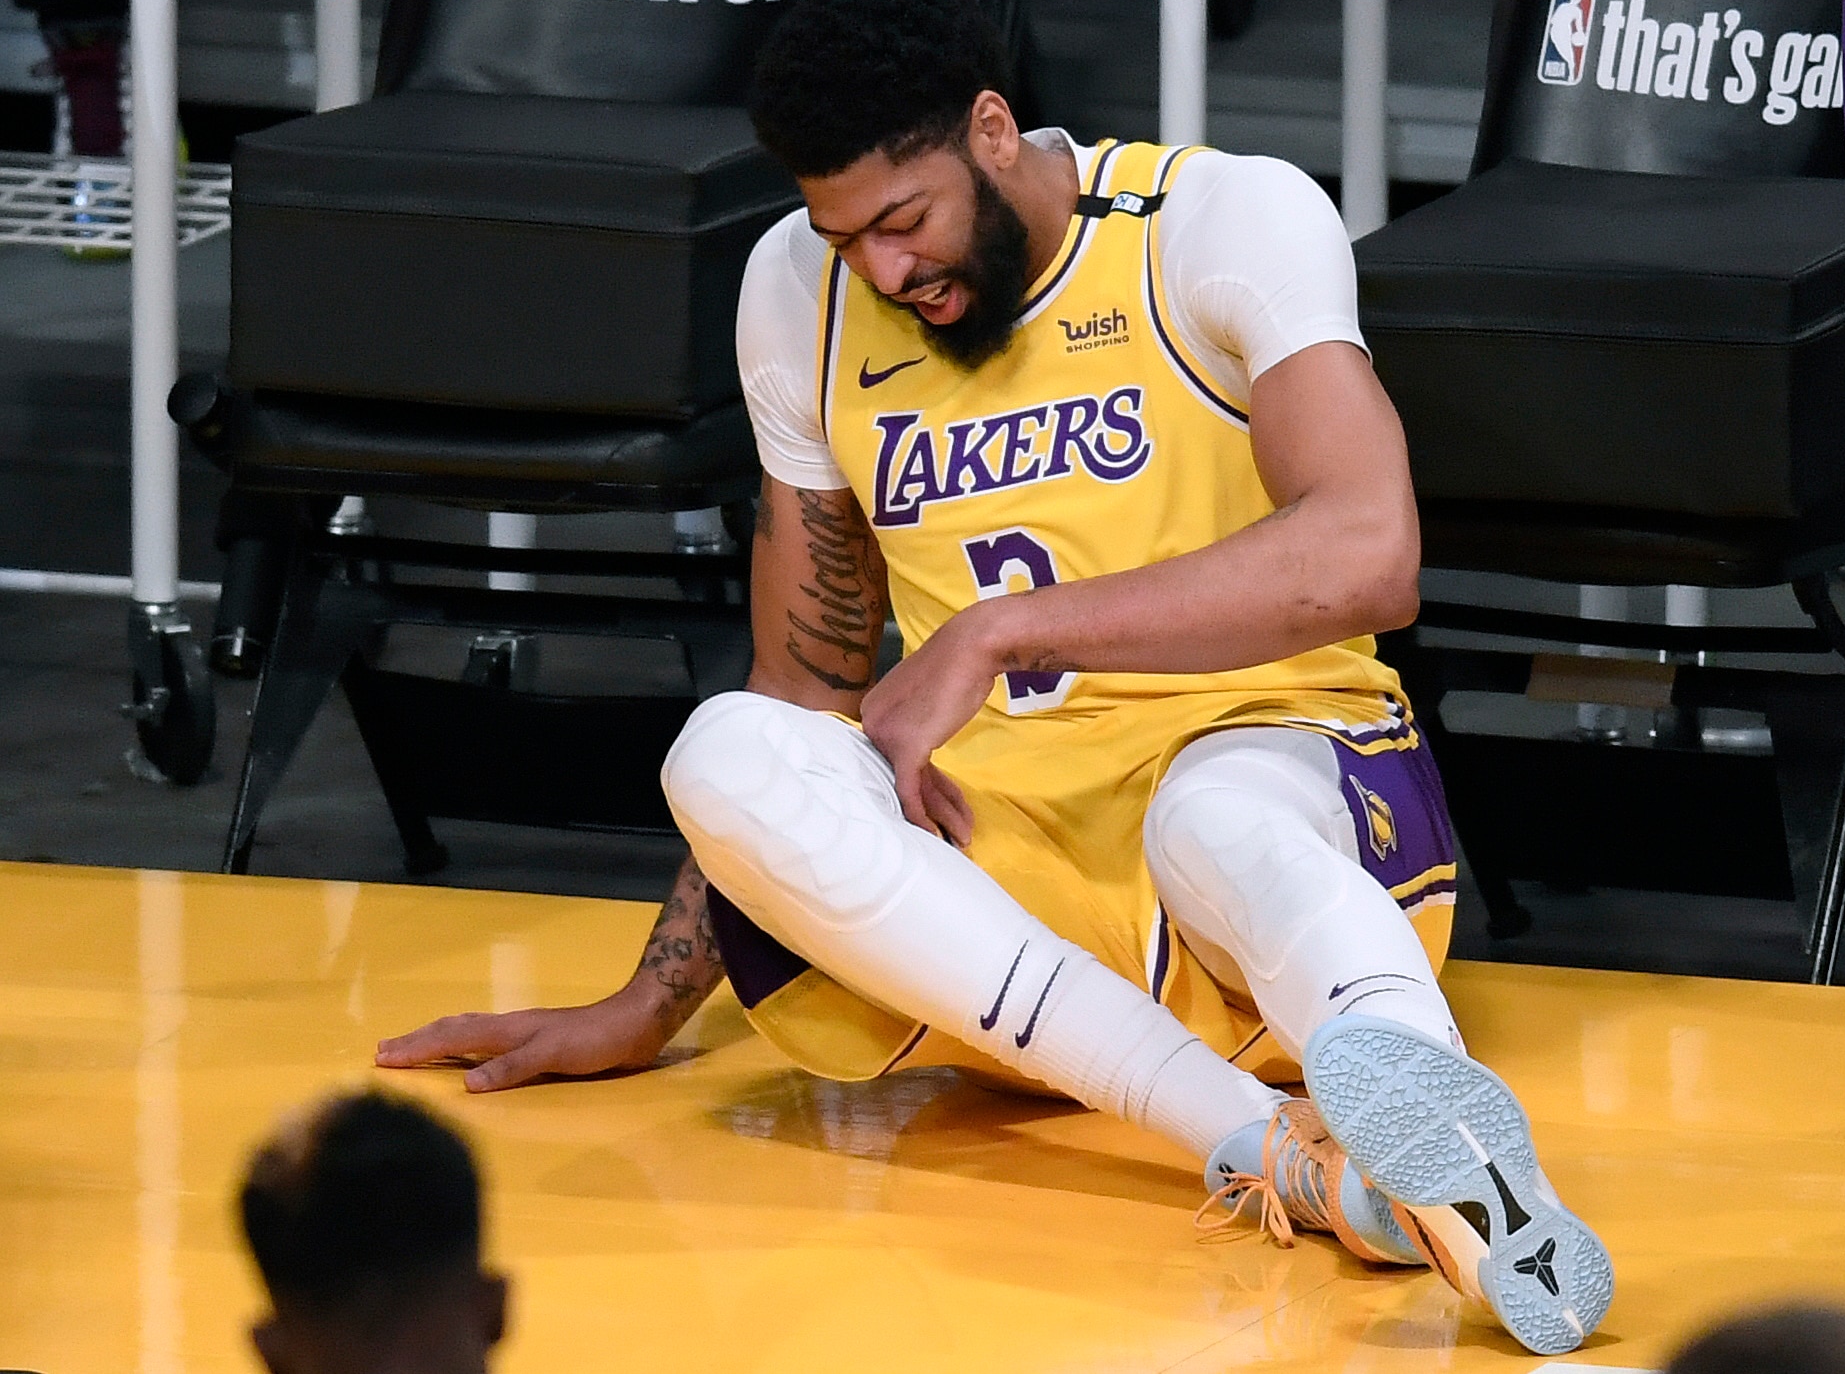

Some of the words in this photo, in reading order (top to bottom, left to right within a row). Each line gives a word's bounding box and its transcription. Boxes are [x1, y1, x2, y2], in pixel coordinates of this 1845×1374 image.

[1762, 32, 1844, 126] ga
[1057, 307, 1128, 341] wish
[1065, 334, 1130, 354] SHOPPING
[871, 384, 1153, 531] LAKERS
